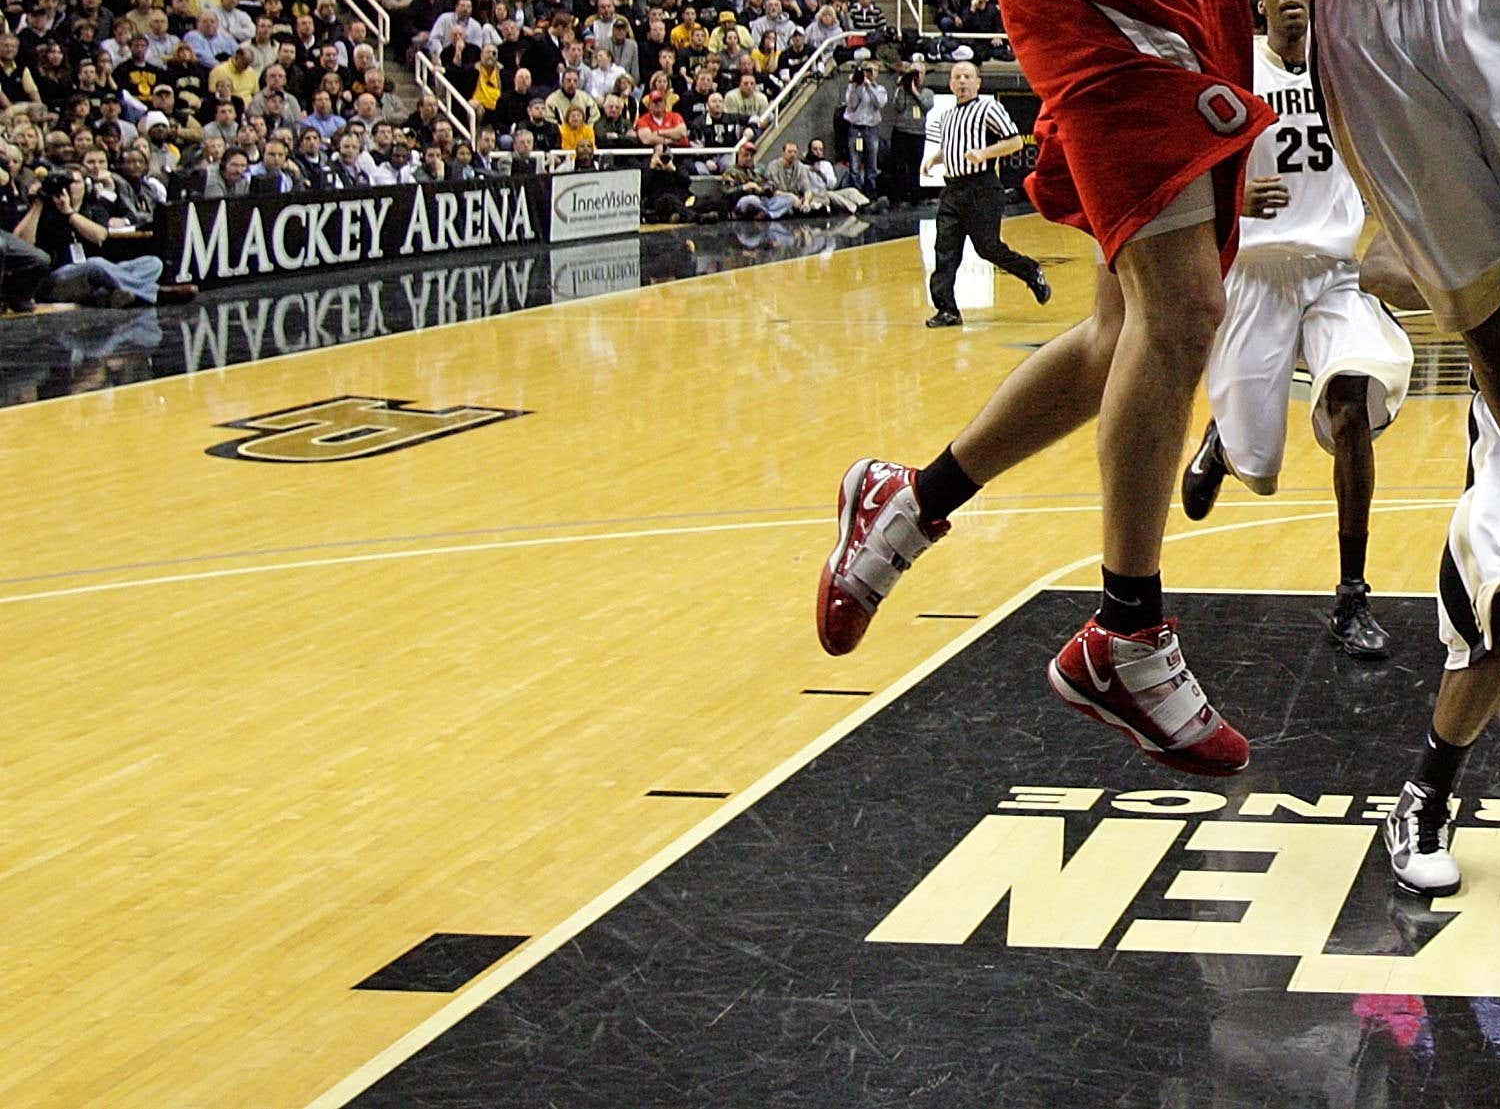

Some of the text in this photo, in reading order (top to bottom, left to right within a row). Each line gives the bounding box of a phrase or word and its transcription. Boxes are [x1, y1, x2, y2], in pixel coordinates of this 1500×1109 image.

[1258, 89, 1319, 115] URD
[1276, 125, 1333, 173] 25
[572, 189, 640, 212] InnerVision
[175, 184, 536, 283] MACKEY ARENA
